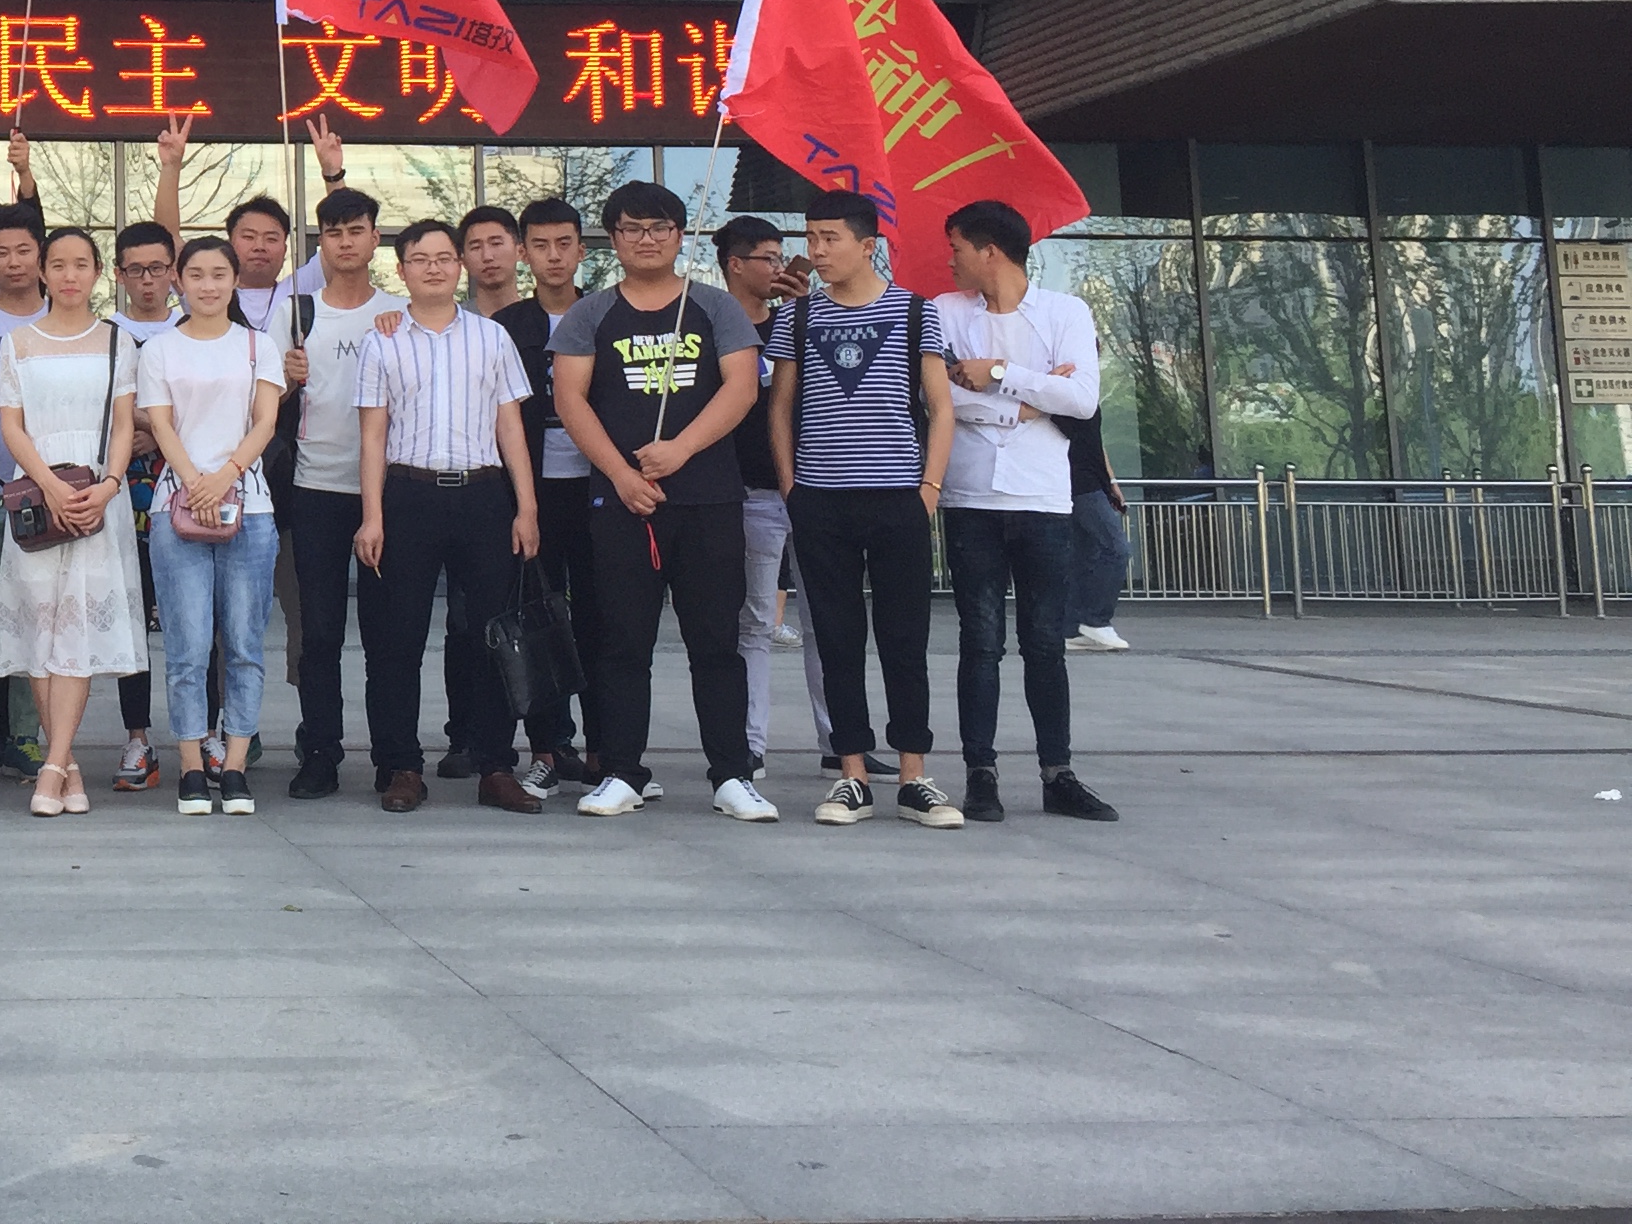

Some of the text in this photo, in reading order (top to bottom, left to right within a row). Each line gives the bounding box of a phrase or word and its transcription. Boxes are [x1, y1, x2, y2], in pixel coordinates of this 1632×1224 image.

[1585, 283, 1625, 294] 应急供电
[1589, 314, 1627, 326] 应急供水
[633, 335, 655, 346] NEW
[613, 333, 702, 363] YANKEES
[1592, 347, 1631, 358] 应急灭火器
